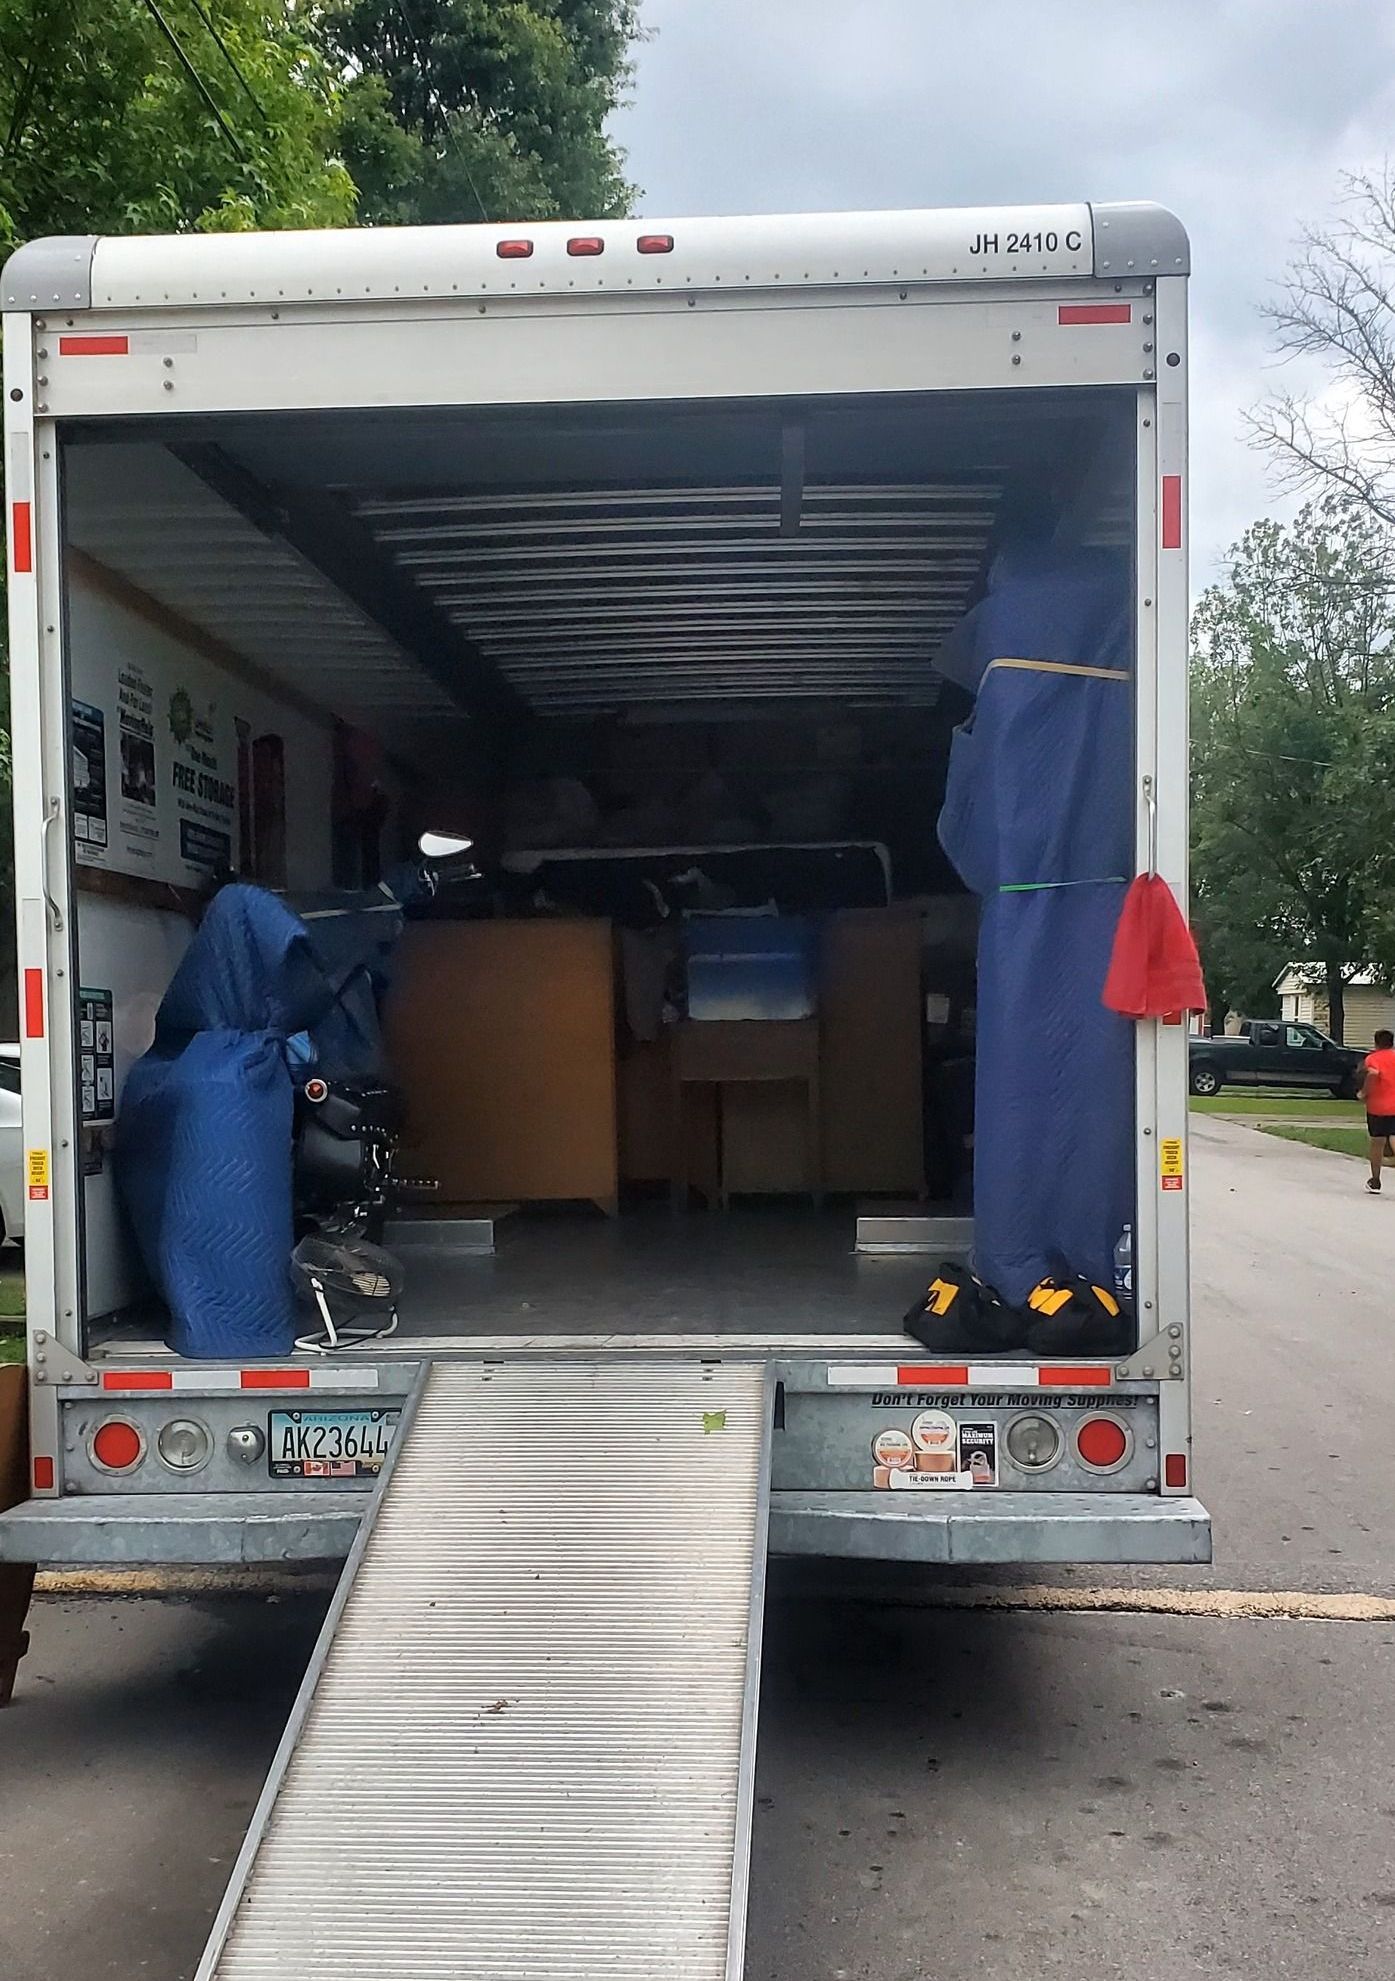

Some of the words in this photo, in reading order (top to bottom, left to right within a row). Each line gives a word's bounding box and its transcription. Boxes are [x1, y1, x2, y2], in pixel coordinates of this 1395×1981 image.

[969, 233, 999, 254] JH
[1006, 232, 1058, 253] 2410
[1065, 231, 1082, 251] C
[172, 761, 196, 794] FREE
[871, 1392, 913, 1406] Don't
[916, 1392, 965, 1409] Forget
[970, 1392, 1003, 1406] Your
[1007, 1393, 1061, 1409] Moving
[303, 1414, 371, 1422] ARIZONA
[282, 1425, 388, 1459] AK23644
[909, 1475, 939, 1483] TIE-DOWN
[940, 1475, 957, 1483] ROPE
